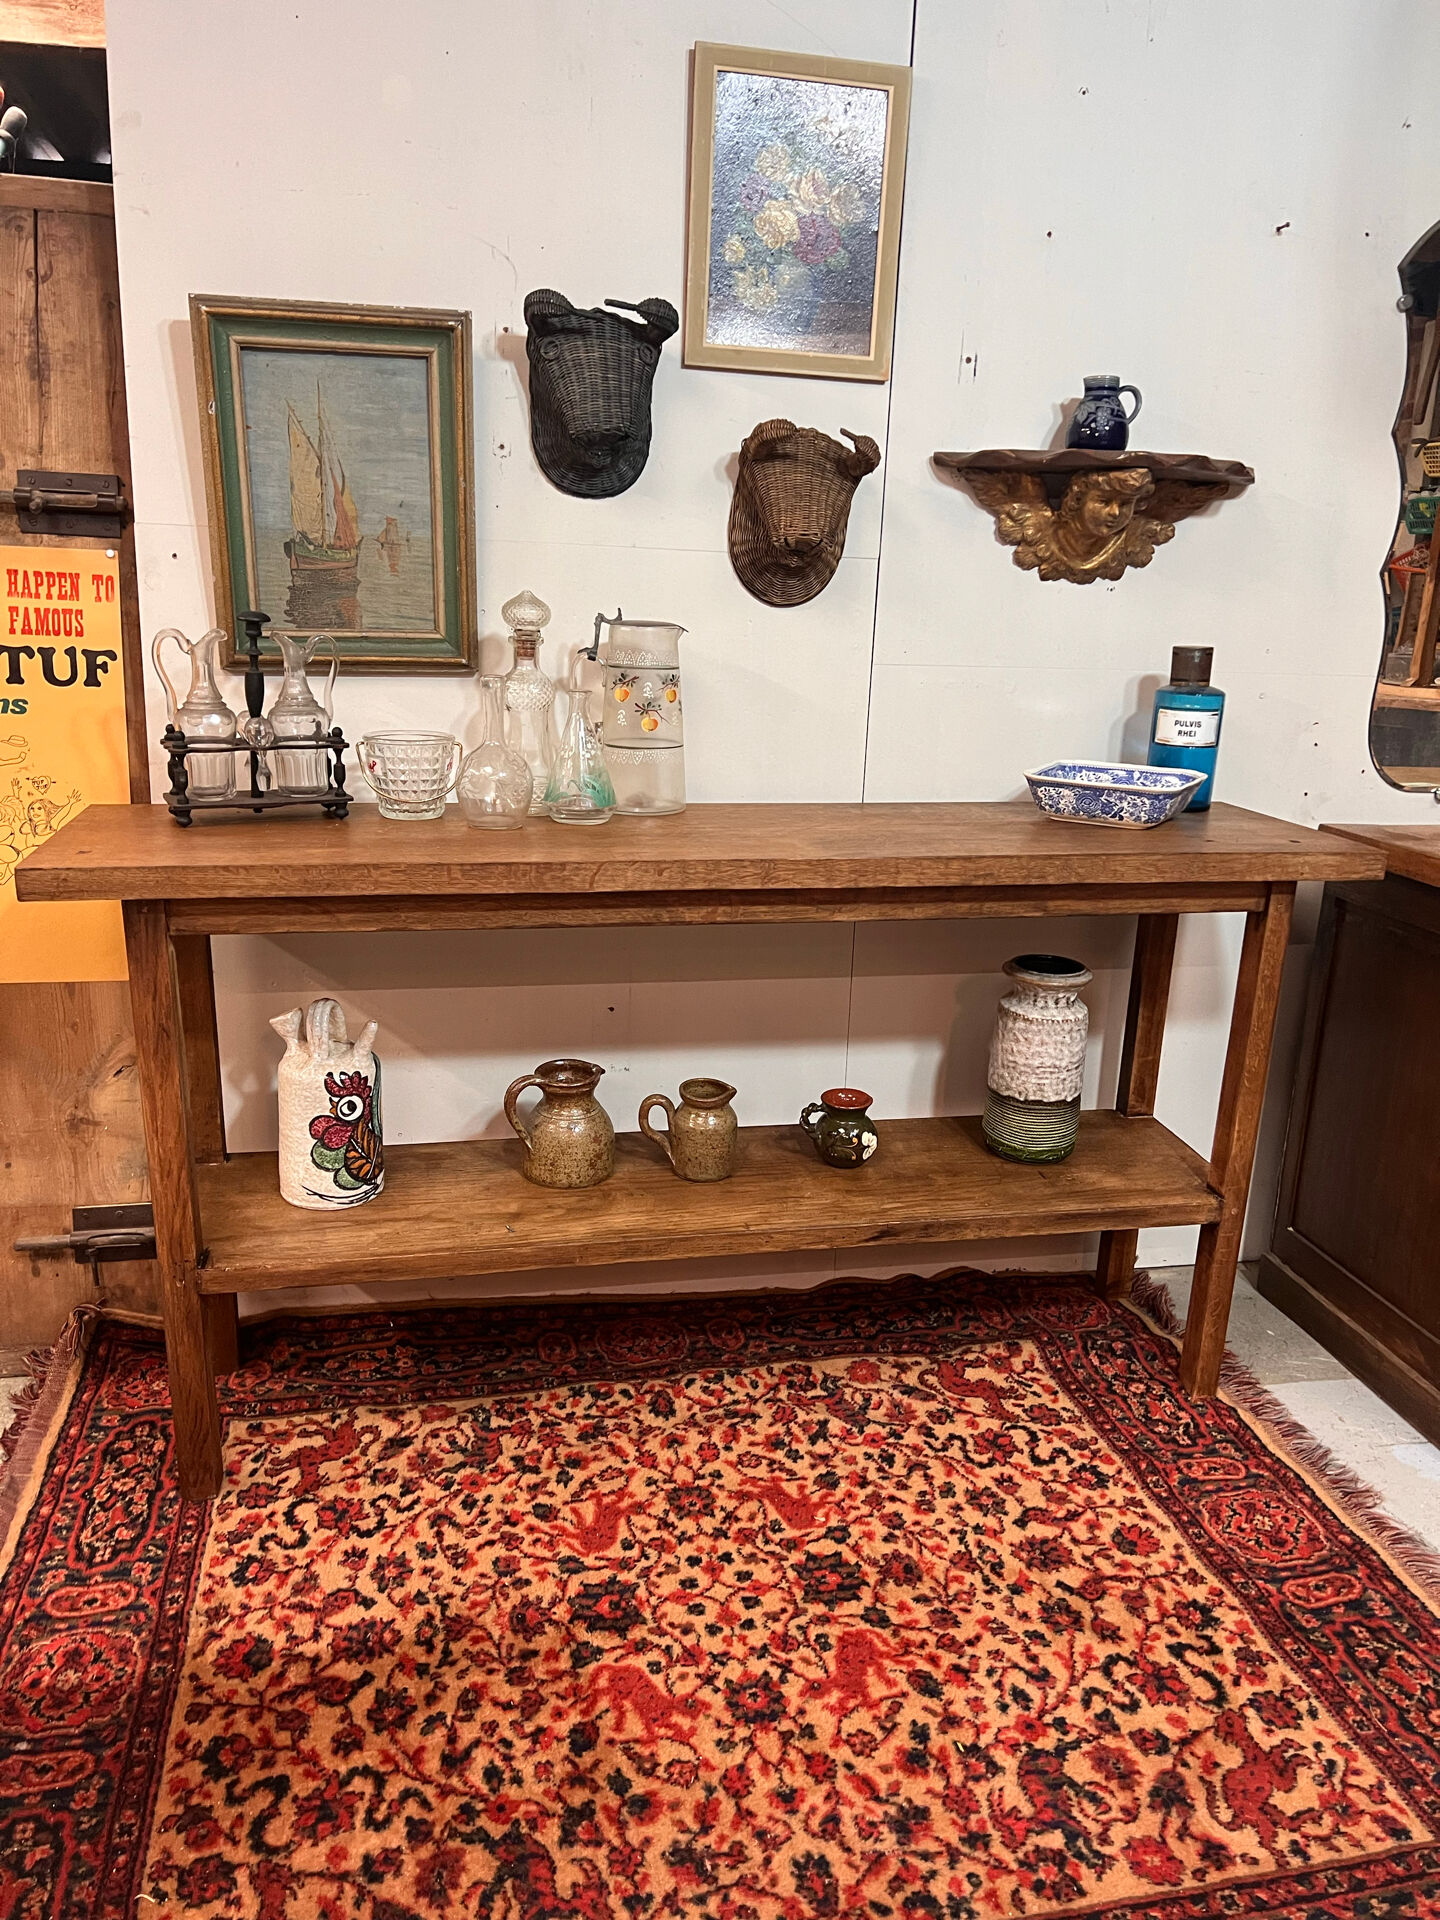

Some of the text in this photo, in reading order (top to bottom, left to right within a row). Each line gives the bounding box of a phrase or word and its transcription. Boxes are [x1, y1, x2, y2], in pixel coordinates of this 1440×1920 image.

[6, 568, 115, 603] HAPPEN TO
[8, 605, 84, 637] FAMOUS
[0, 644, 118, 688] TUF
[1174, 719, 1202, 728] PULVIS
[1177, 729, 1197, 737] RHEI
